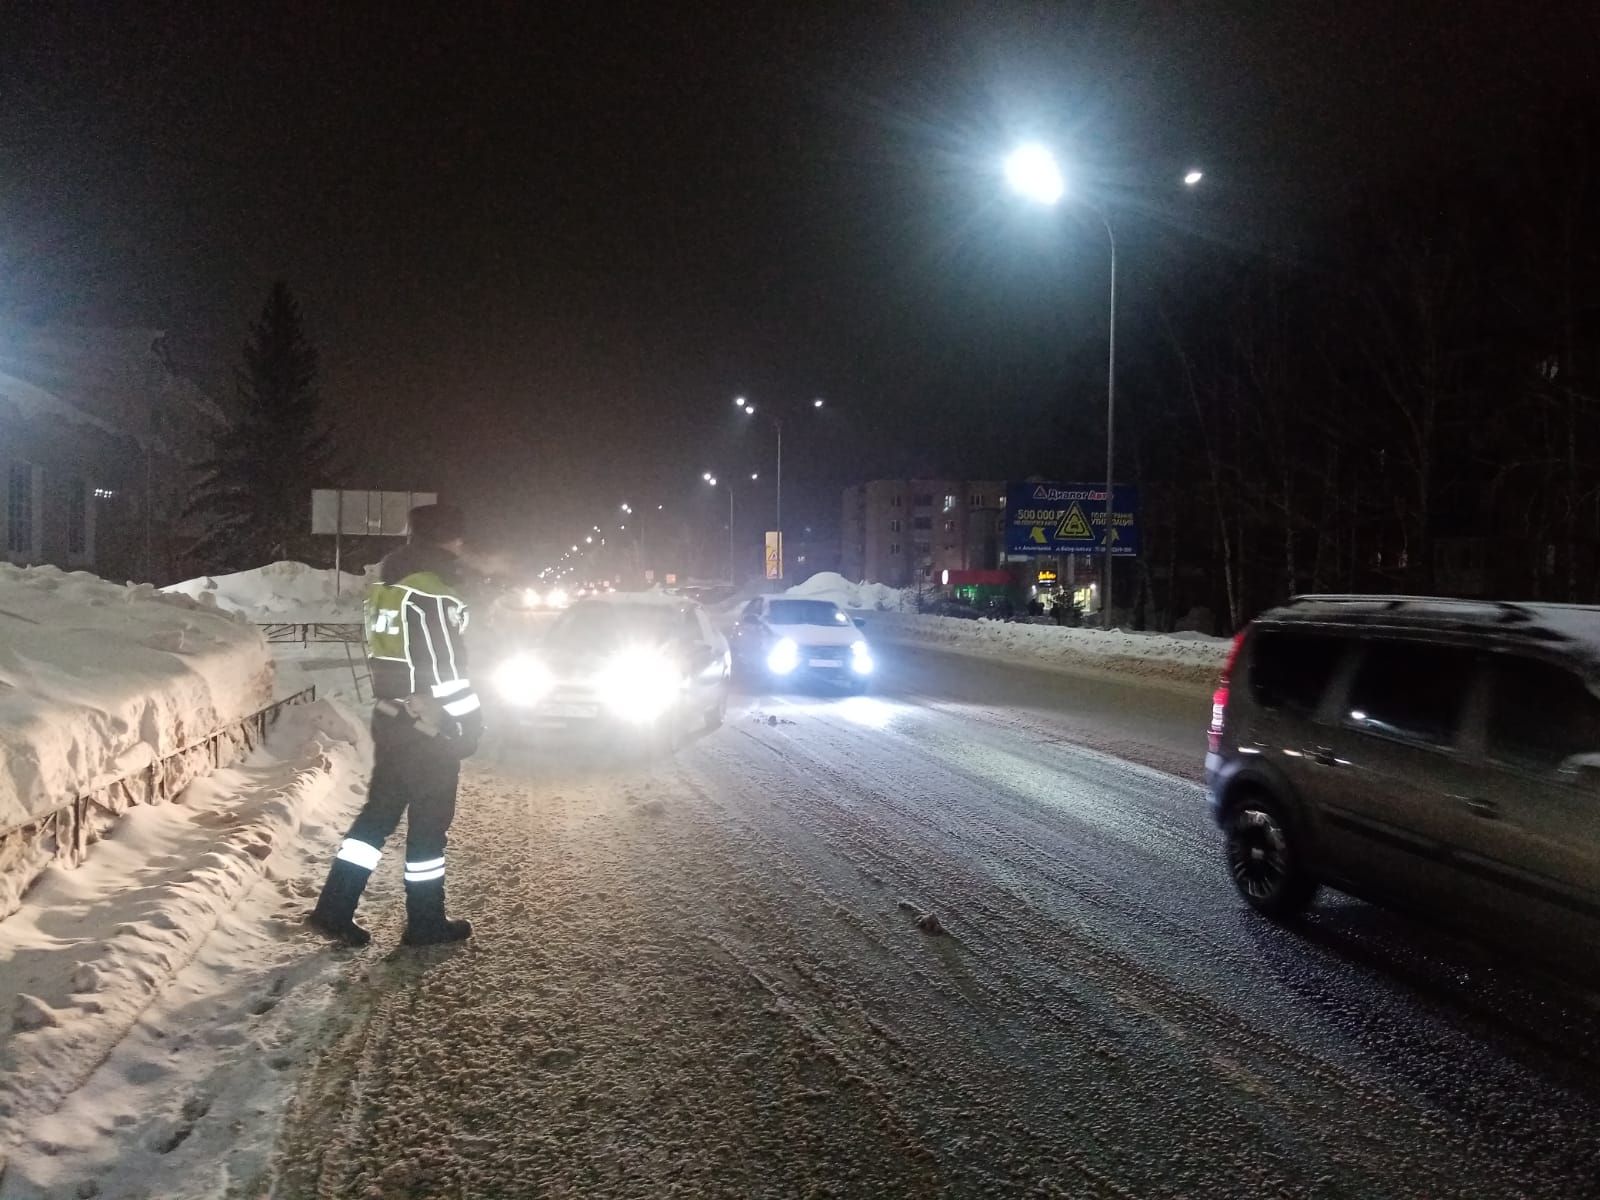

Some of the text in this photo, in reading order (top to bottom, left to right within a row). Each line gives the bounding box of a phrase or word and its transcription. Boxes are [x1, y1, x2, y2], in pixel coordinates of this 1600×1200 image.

[1048, 489, 1088, 501] Диалог
[1017, 509, 1035, 520] 500
[1037, 510, 1054, 521] 000
